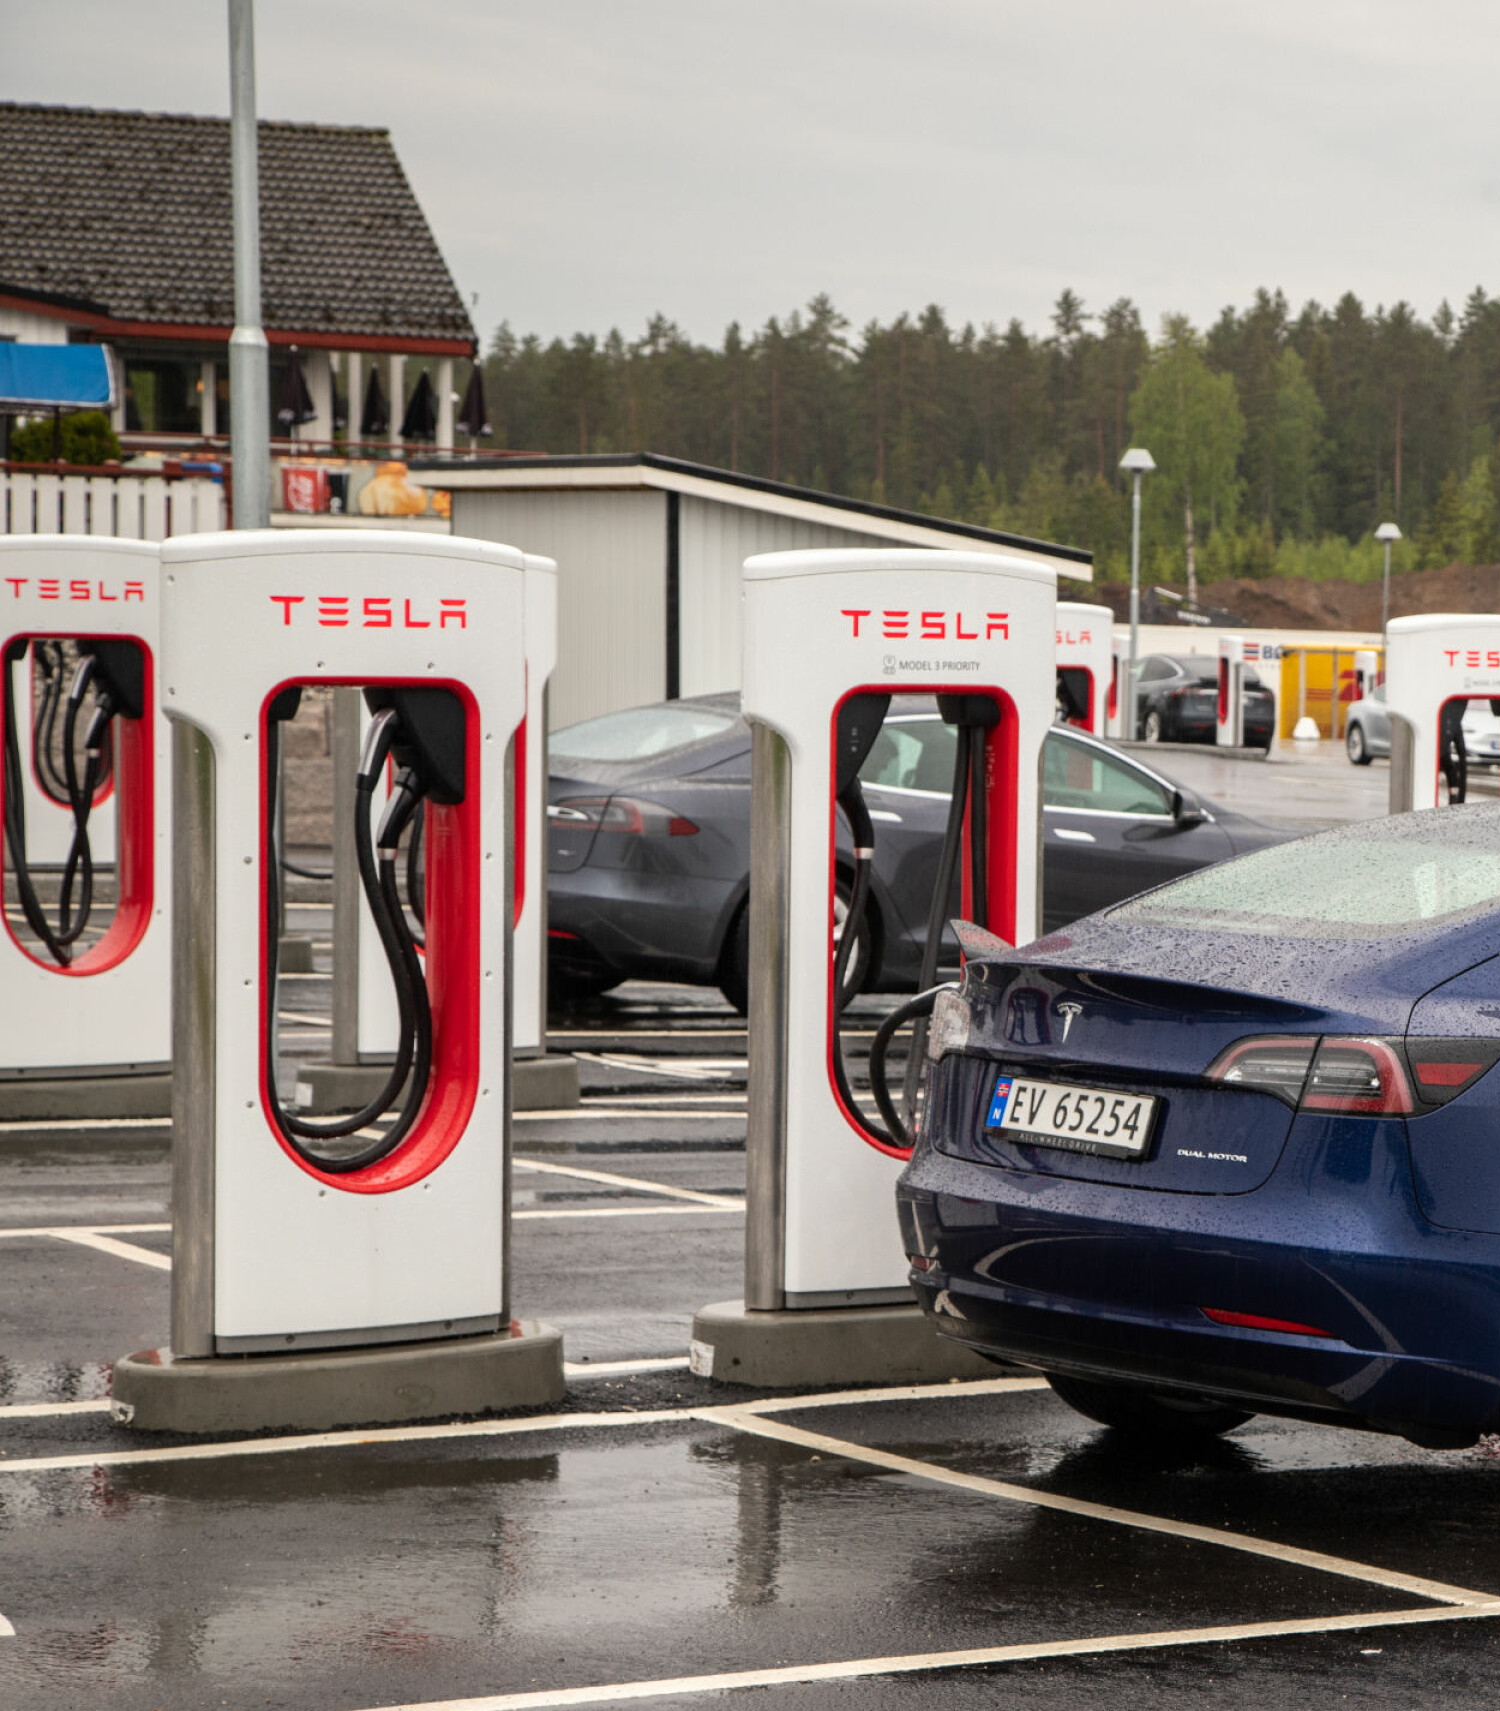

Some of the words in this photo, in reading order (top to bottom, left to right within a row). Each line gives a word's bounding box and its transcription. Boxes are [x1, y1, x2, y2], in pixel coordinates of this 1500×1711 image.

[5, 578, 144, 602] TESLA
[269, 596, 466, 629] TESLA
[840, 610, 1009, 640] TESLA
[899, 660, 932, 671] MODEL
[935, 660, 940, 671] 3
[942, 661, 980, 672] PRIORITY
[1008, 1086, 1047, 1126] EV
[1051, 1092, 1142, 1141] 65254
[1177, 1149, 1206, 1158] DUAL
[1207, 1152, 1248, 1163] MOTOR
